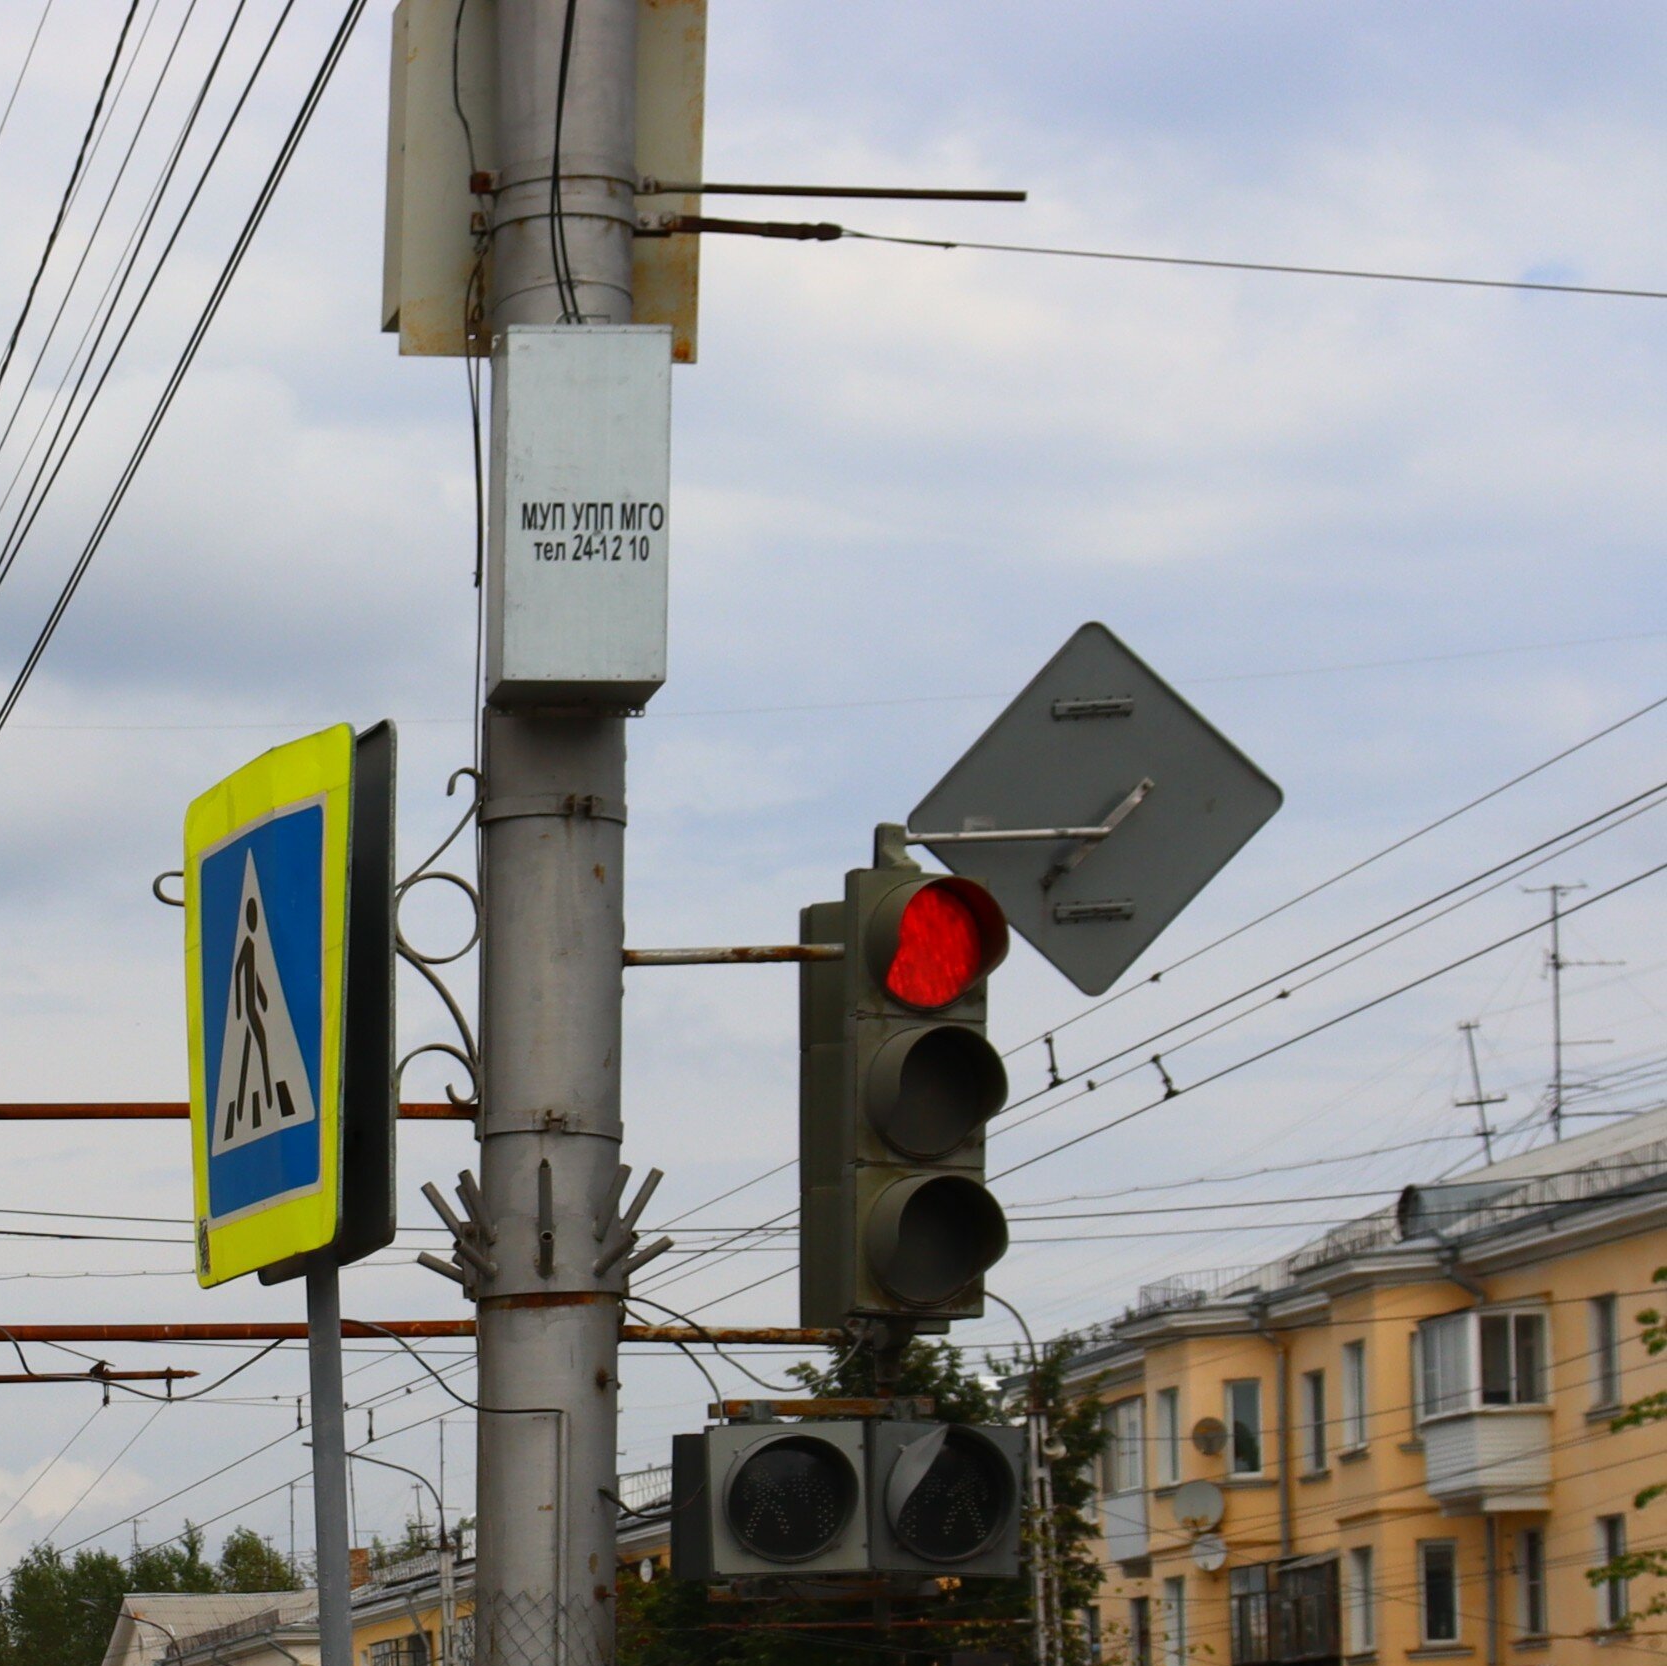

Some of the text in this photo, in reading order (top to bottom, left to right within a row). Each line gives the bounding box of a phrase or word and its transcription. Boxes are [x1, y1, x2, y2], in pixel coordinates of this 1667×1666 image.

[521, 502, 664, 531] МУП УПП МГО
[534, 541, 566, 561] тел
